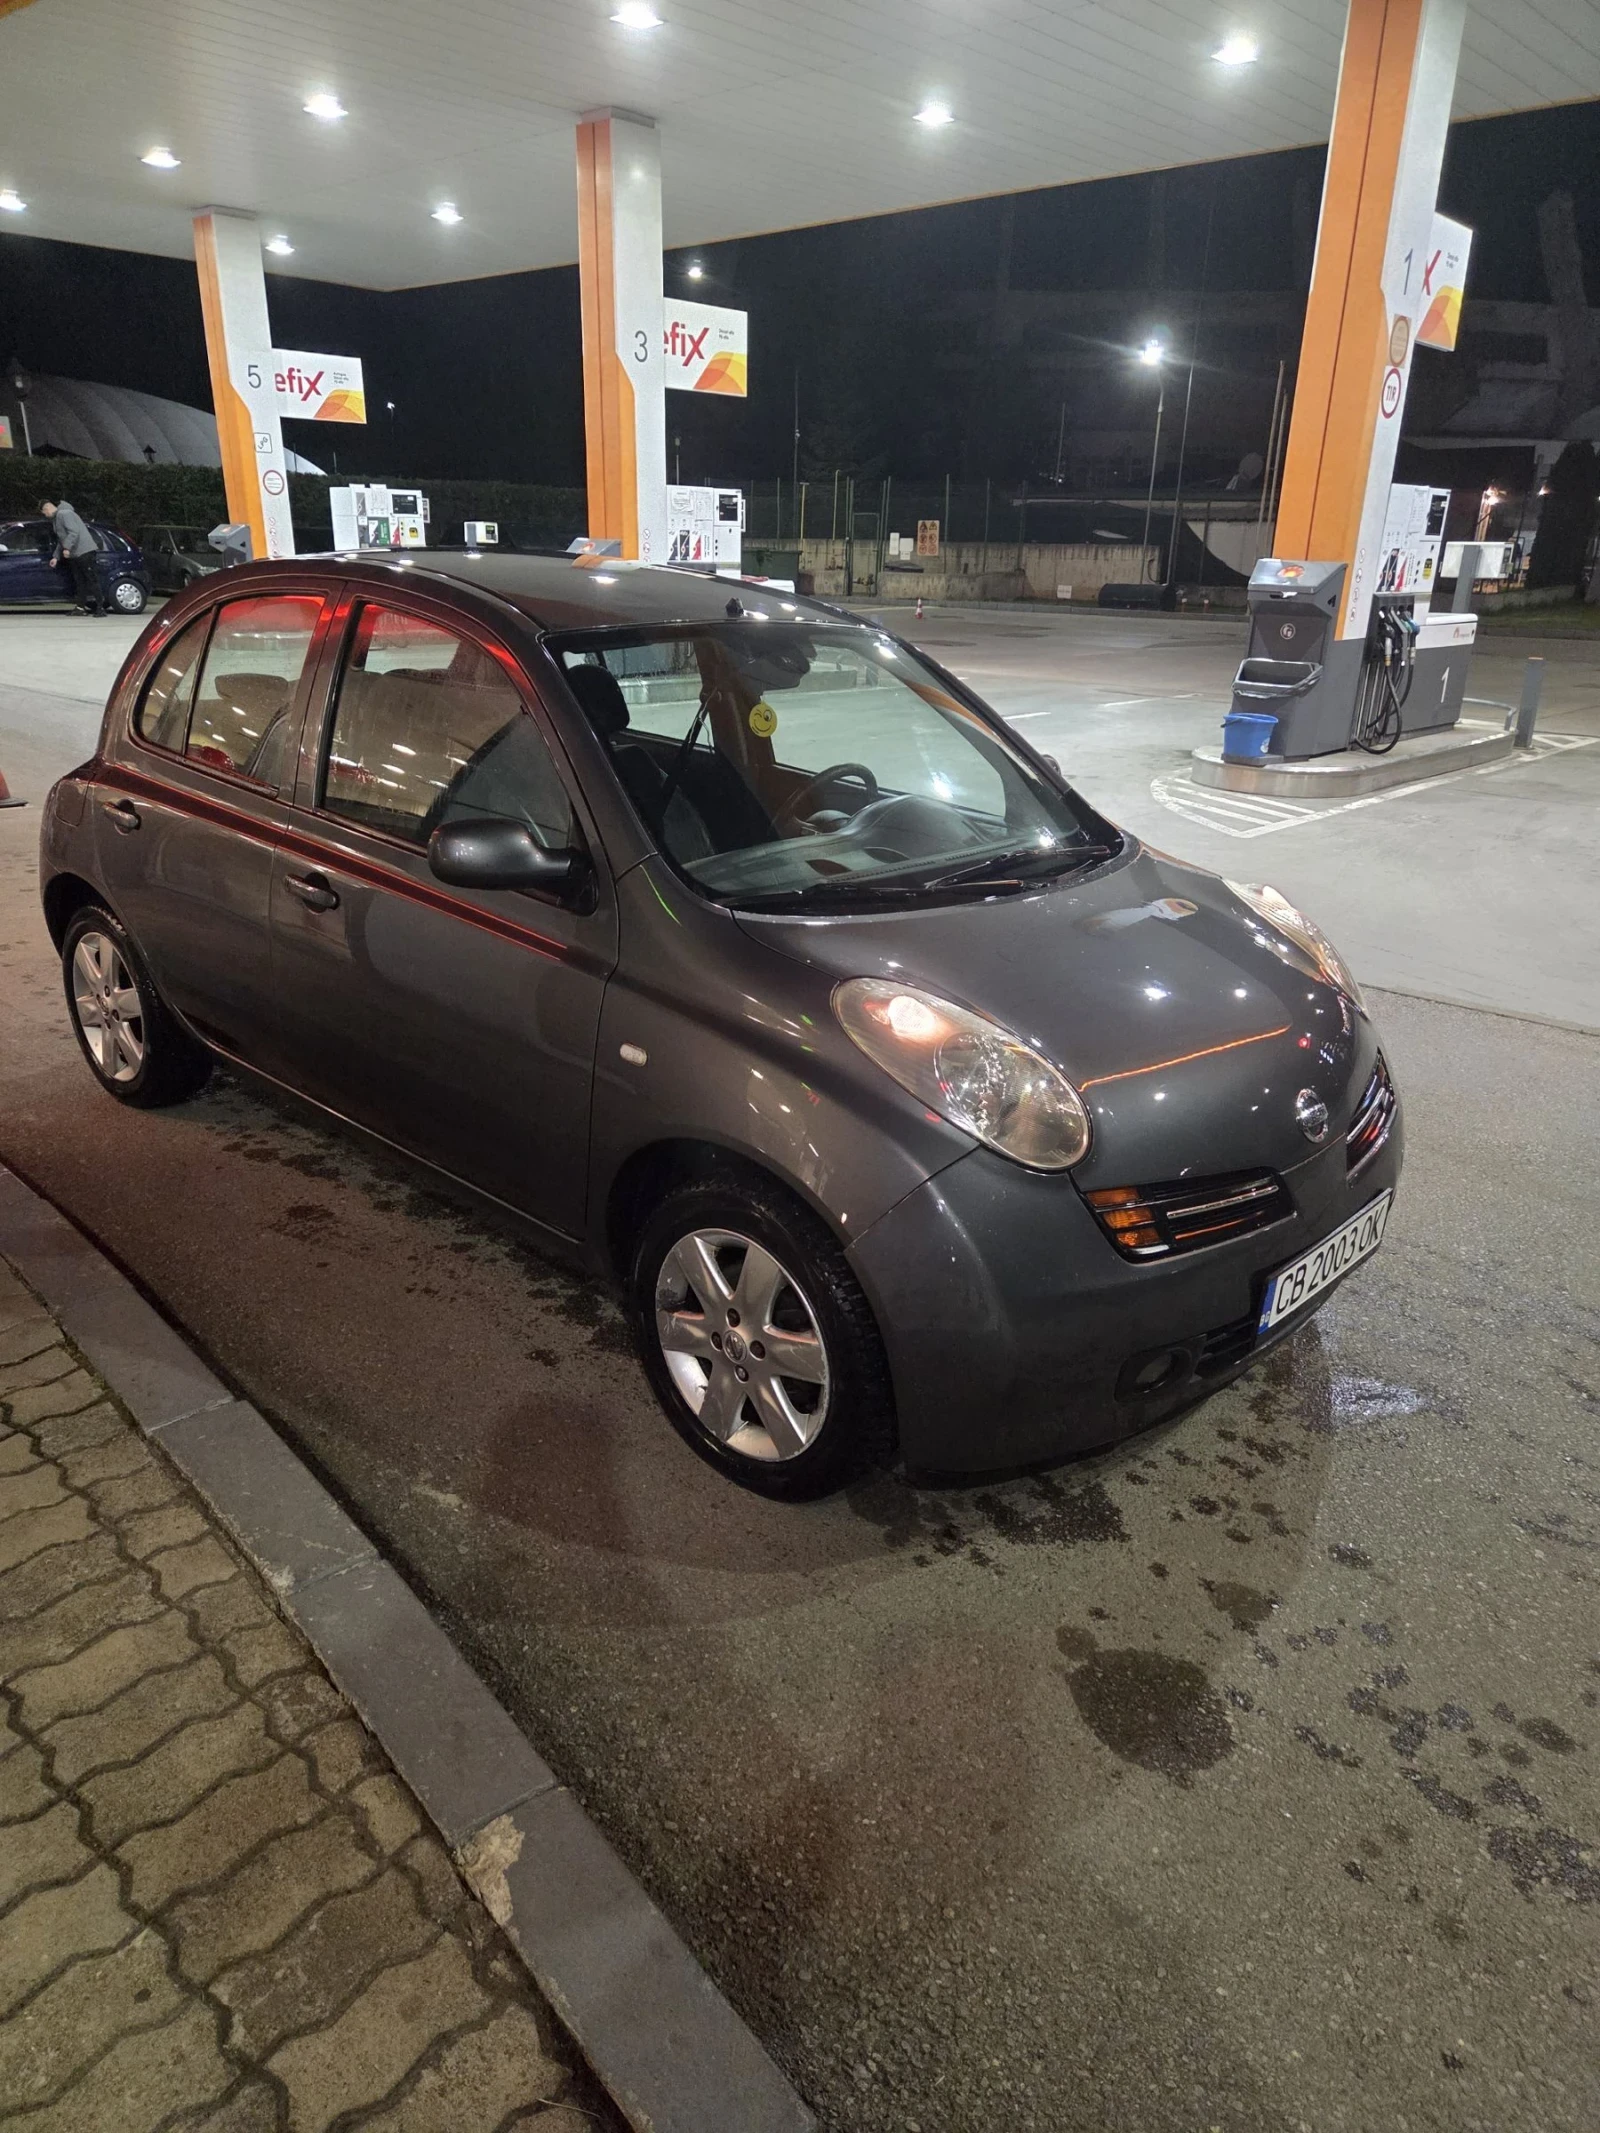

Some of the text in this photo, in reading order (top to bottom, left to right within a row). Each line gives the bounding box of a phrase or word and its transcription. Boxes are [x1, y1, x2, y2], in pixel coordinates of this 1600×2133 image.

[1404, 248, 1413, 295] 1
[634, 330, 648, 363] 3
[248, 364, 261, 389] 5
[274, 367, 325, 401] efix
[1386, 385, 1397, 402] TIR
[1441, 666, 1450, 703] 1
[1276, 1204, 1386, 1315] CB 2003 OK
